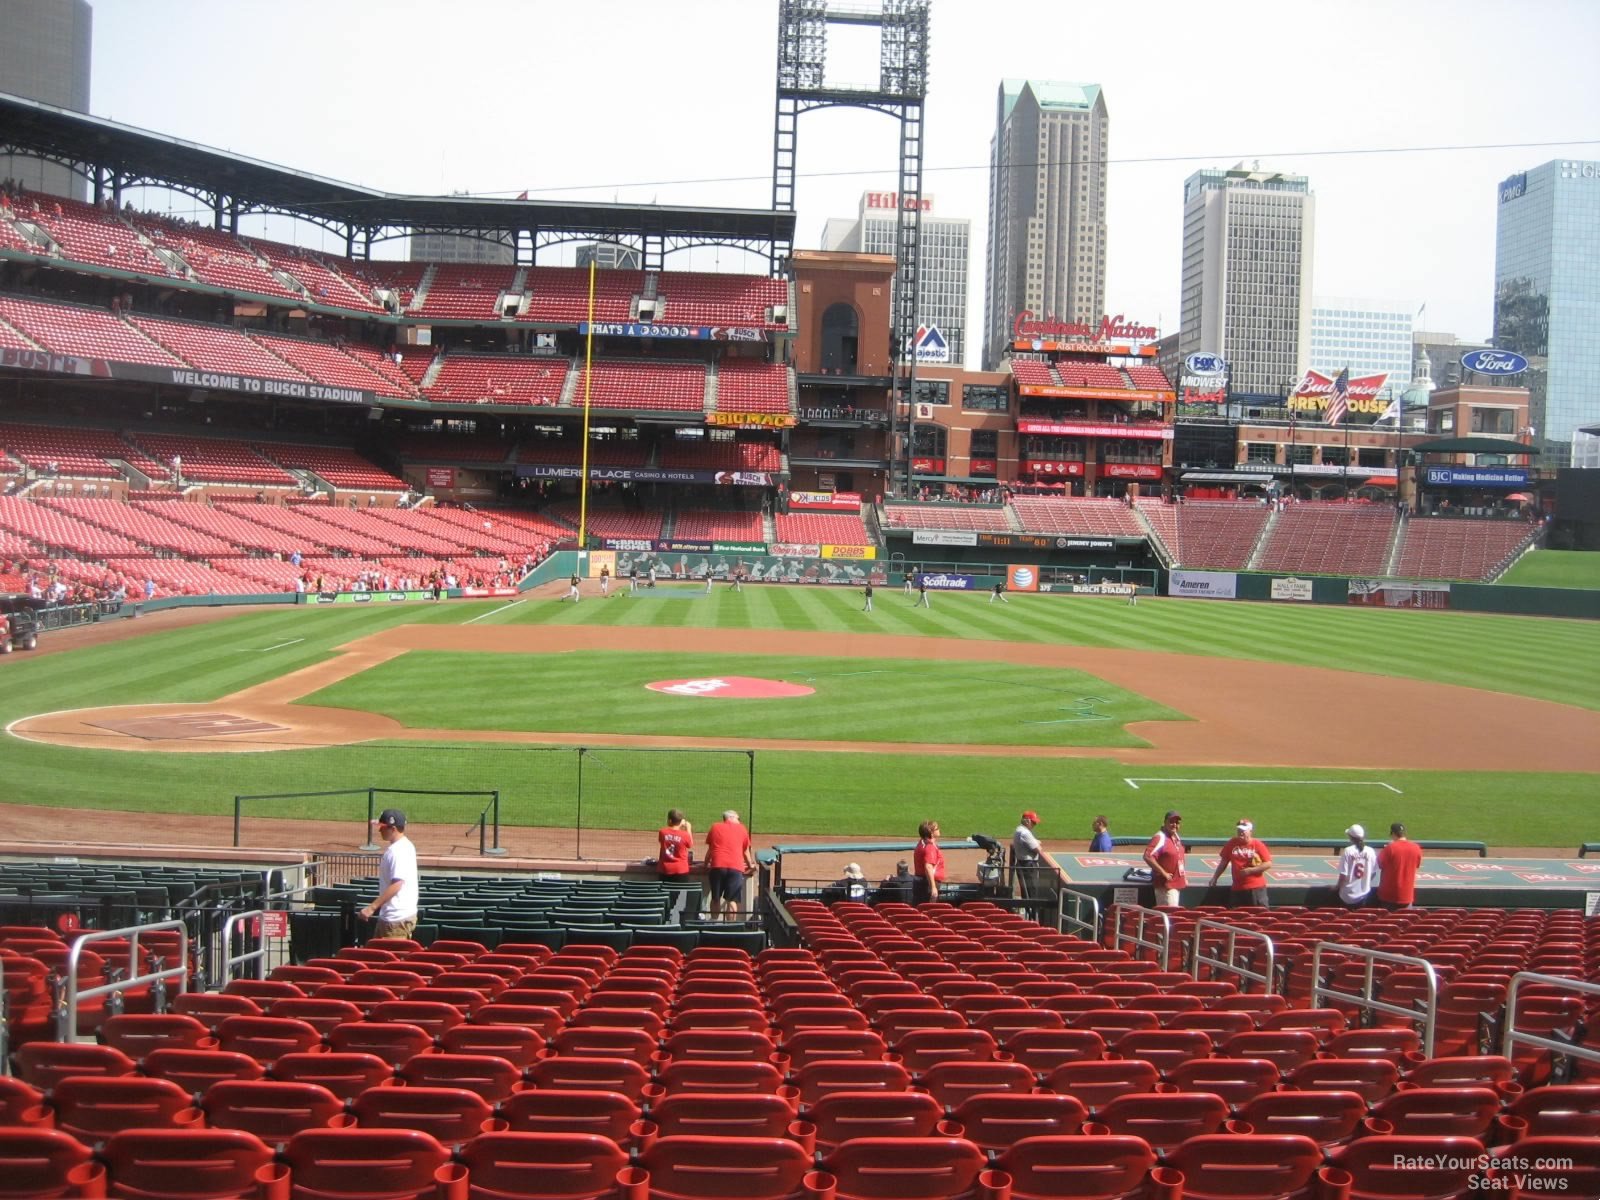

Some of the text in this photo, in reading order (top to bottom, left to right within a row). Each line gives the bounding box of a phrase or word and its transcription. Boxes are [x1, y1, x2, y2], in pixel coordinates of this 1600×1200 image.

[867, 192, 931, 211] Hilon
[591, 325, 622, 335] THAT'S
[628, 327, 634, 335] A
[1014, 310, 1157, 341] Cardinals Nation
[1055, 342, 1116, 353] AT&T ROOFTOP
[1194, 357, 1216, 369] FOX
[1475, 352, 1515, 370] Ford
[172, 370, 363, 402] WELCOME TO BUSCH STADIUM
[1180, 376, 1228, 387] MIDWEST
[1293, 377, 1386, 395] Budeiser
[1346, 400, 1388, 413] OUSE
[716, 412, 785, 427] BIG MAC
[590, 470, 631, 479] PLACE
[1430, 471, 1448, 481] BJC
[1453, 473, 1474, 481] Making
[916, 535, 935, 543] Mercy
[832, 546, 865, 555] DOBBS
[922, 574, 967, 588] Scottrade
[1180, 580, 1210, 590] Ameren
[1073, 585, 1100, 593] BUSCH
[1354, 862, 1364, 879] 6
